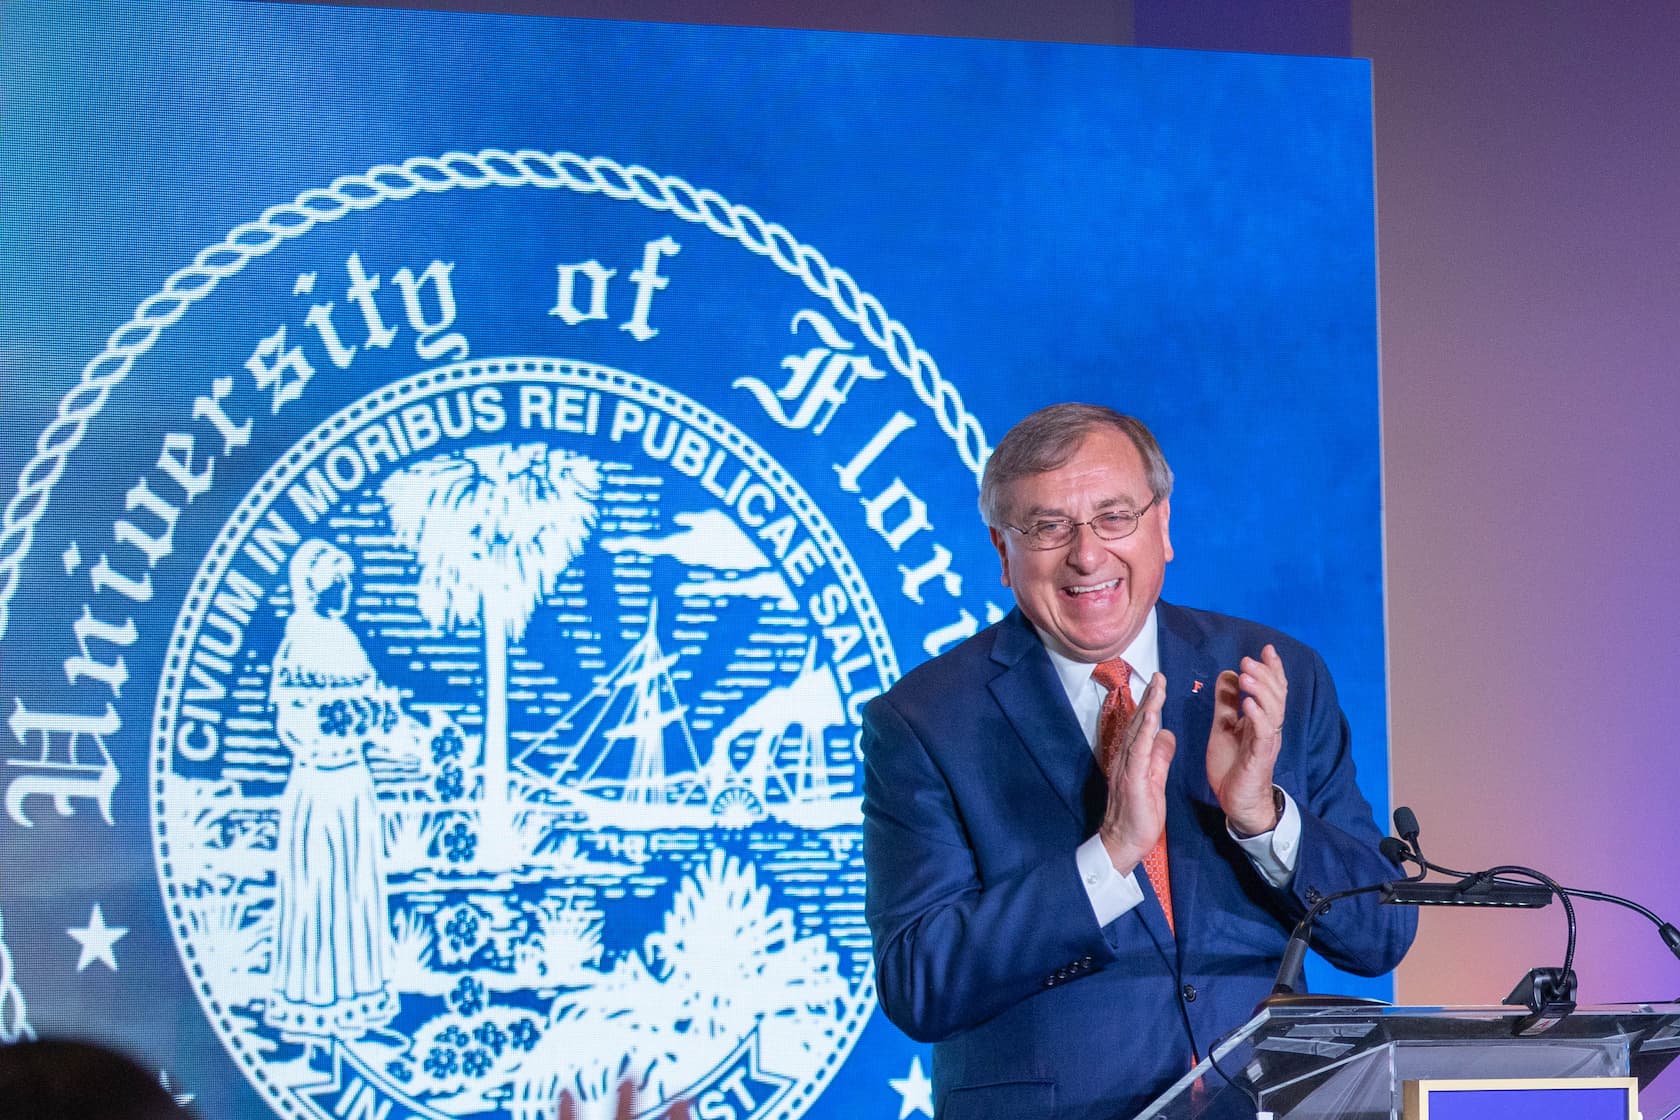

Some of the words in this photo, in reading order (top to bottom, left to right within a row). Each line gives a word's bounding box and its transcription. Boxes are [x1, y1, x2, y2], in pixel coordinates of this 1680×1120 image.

[5, 252, 470, 827] University
[548, 234, 683, 342] of
[732, 308, 1004, 657] Flori
[176, 569, 265, 763] CIVIUM
[243, 510, 302, 575] IN
[287, 386, 507, 524] MORIBUS
[519, 385, 599, 436] REI
[610, 399, 826, 587] PUBLICAE
